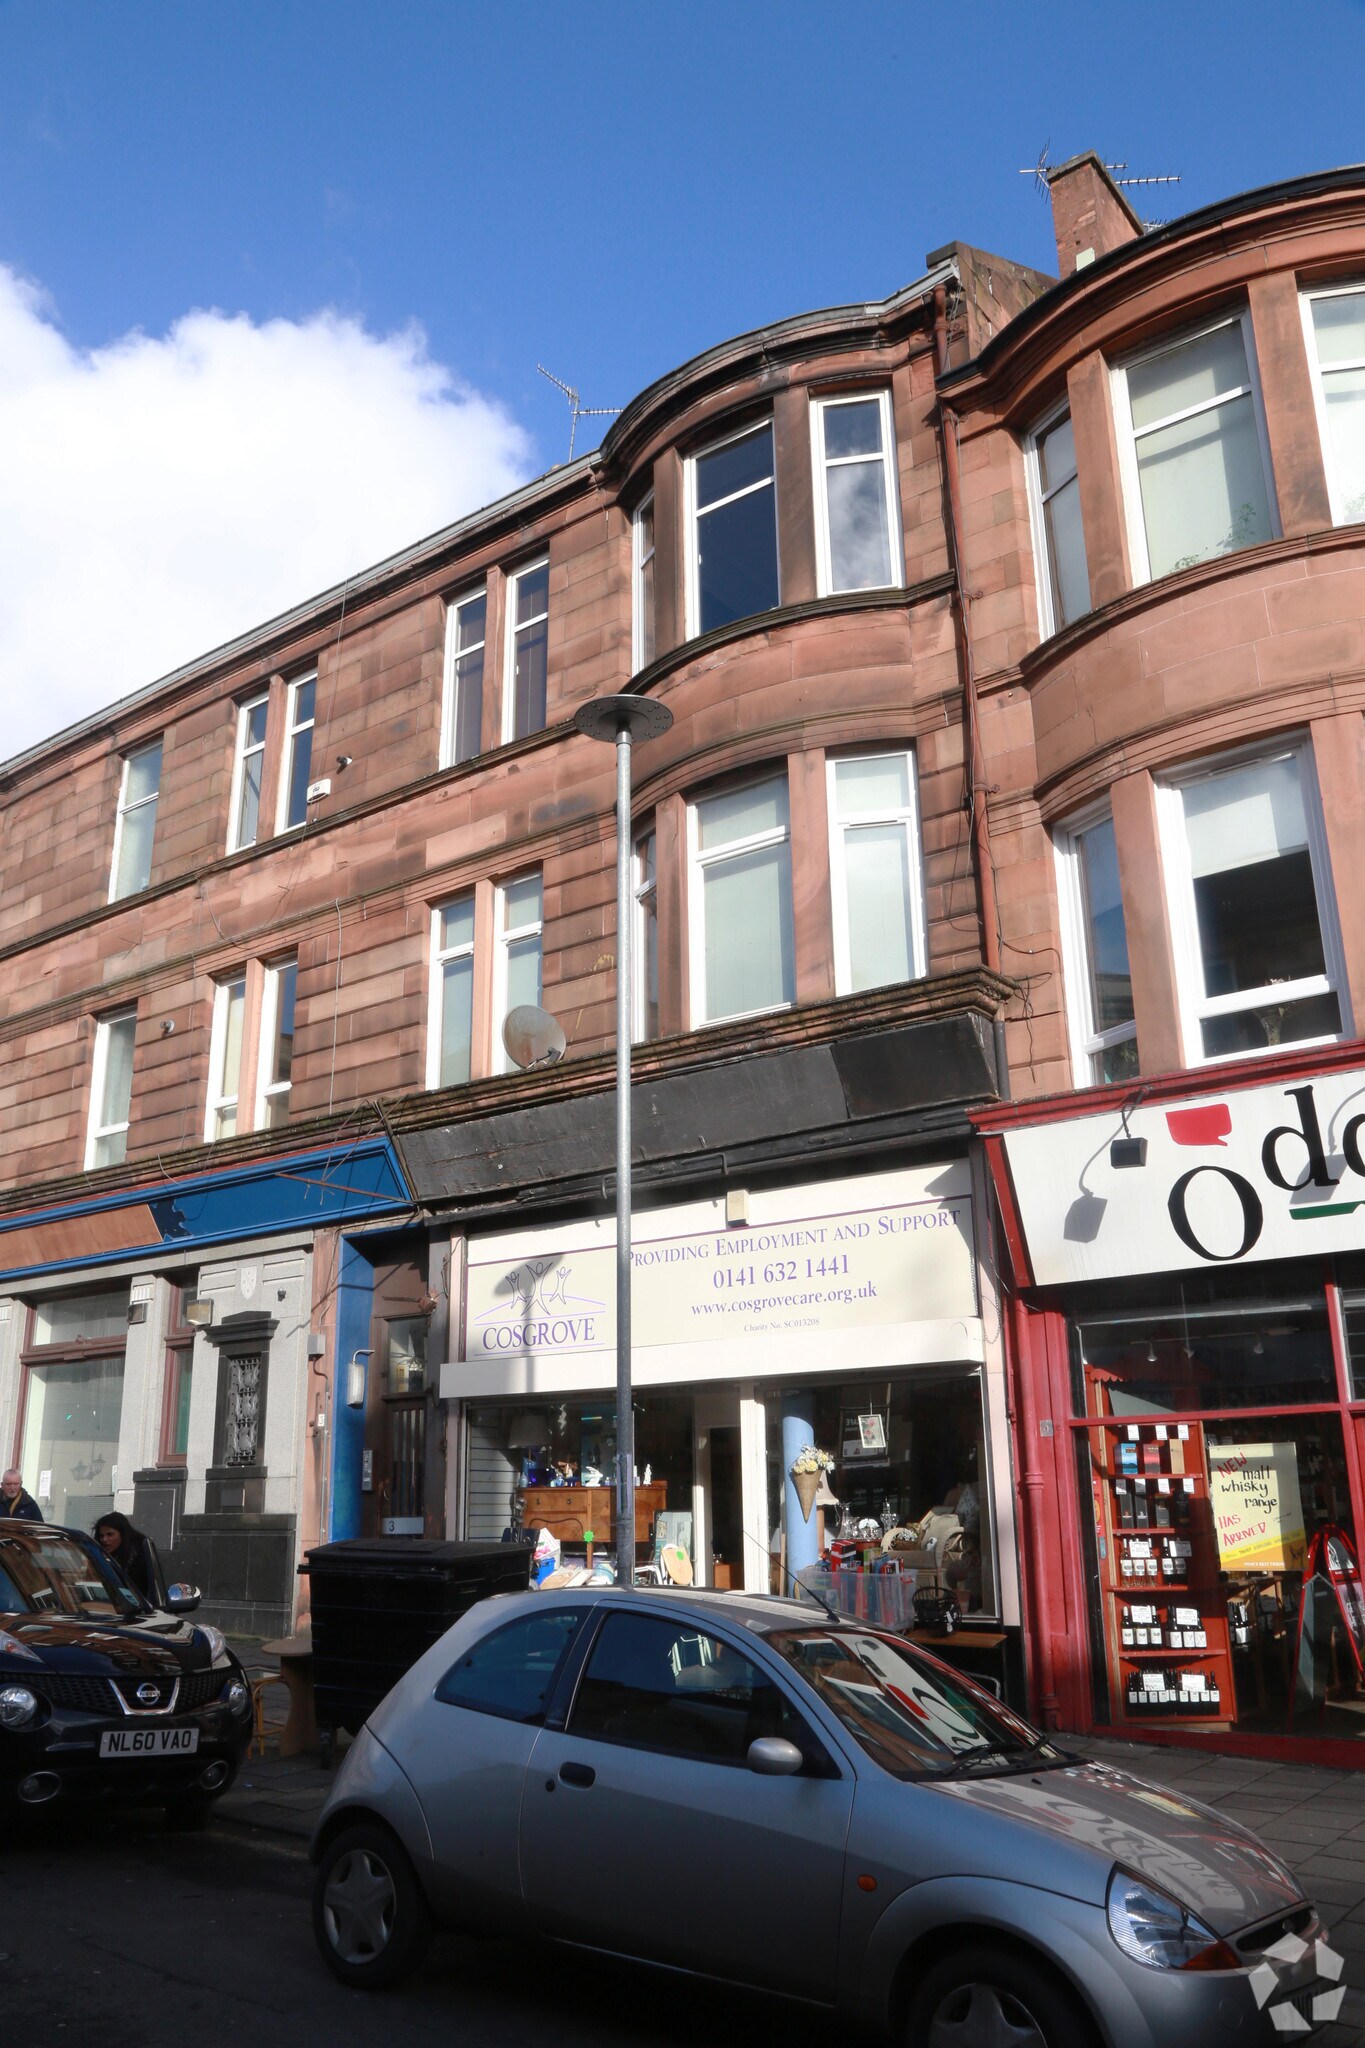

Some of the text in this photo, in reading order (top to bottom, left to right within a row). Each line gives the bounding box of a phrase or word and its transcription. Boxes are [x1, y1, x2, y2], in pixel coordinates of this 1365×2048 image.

[716, 1229, 827, 1256] EMPLOYMENT
[834, 1222, 870, 1241] AND
[878, 1210, 960, 1235] SUPPORT
[713, 1255, 849, 1288] 0141 632 1441
[692, 1280, 877, 1315] www.cosgrovecare.org.uk
[483, 1318, 595, 1350] COSGROVE
[744, 1323, 768, 1333] Charity
[1217, 1452, 1248, 1478] NEW
[1243, 1465, 1271, 1480] malt
[1221, 1480, 1268, 1498] whisky
[1244, 1498, 1278, 1514] range
[389, 1520, 395, 1532] 3
[1218, 1514, 1241, 1529] HAS
[1223, 1522, 1266, 1546] ARRIVED
[108, 1730, 192, 1752] NL60 VAO
